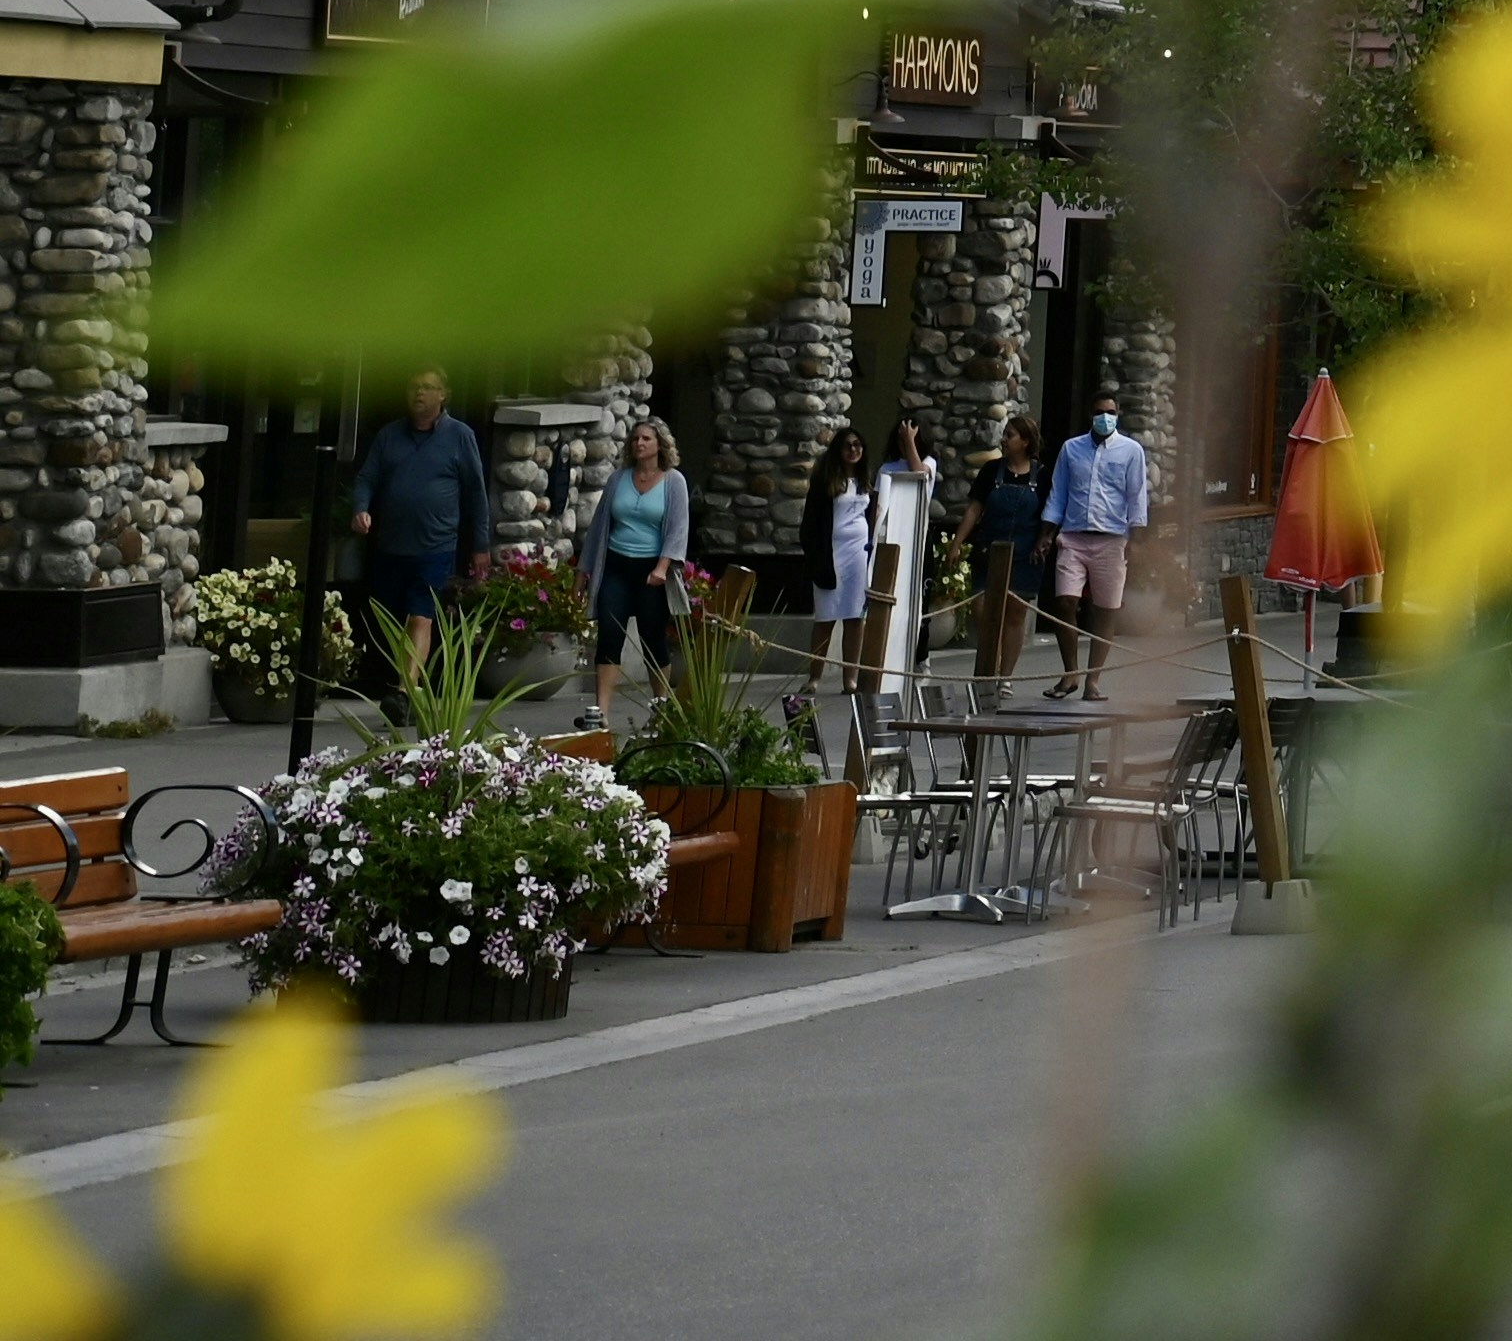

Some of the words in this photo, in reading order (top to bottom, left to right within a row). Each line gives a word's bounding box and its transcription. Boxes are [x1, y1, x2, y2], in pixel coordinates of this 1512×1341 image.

[893, 33, 980, 95] HARMONS
[892, 207, 956, 222] PRACTICE
[860, 237, 875, 299] yoga
